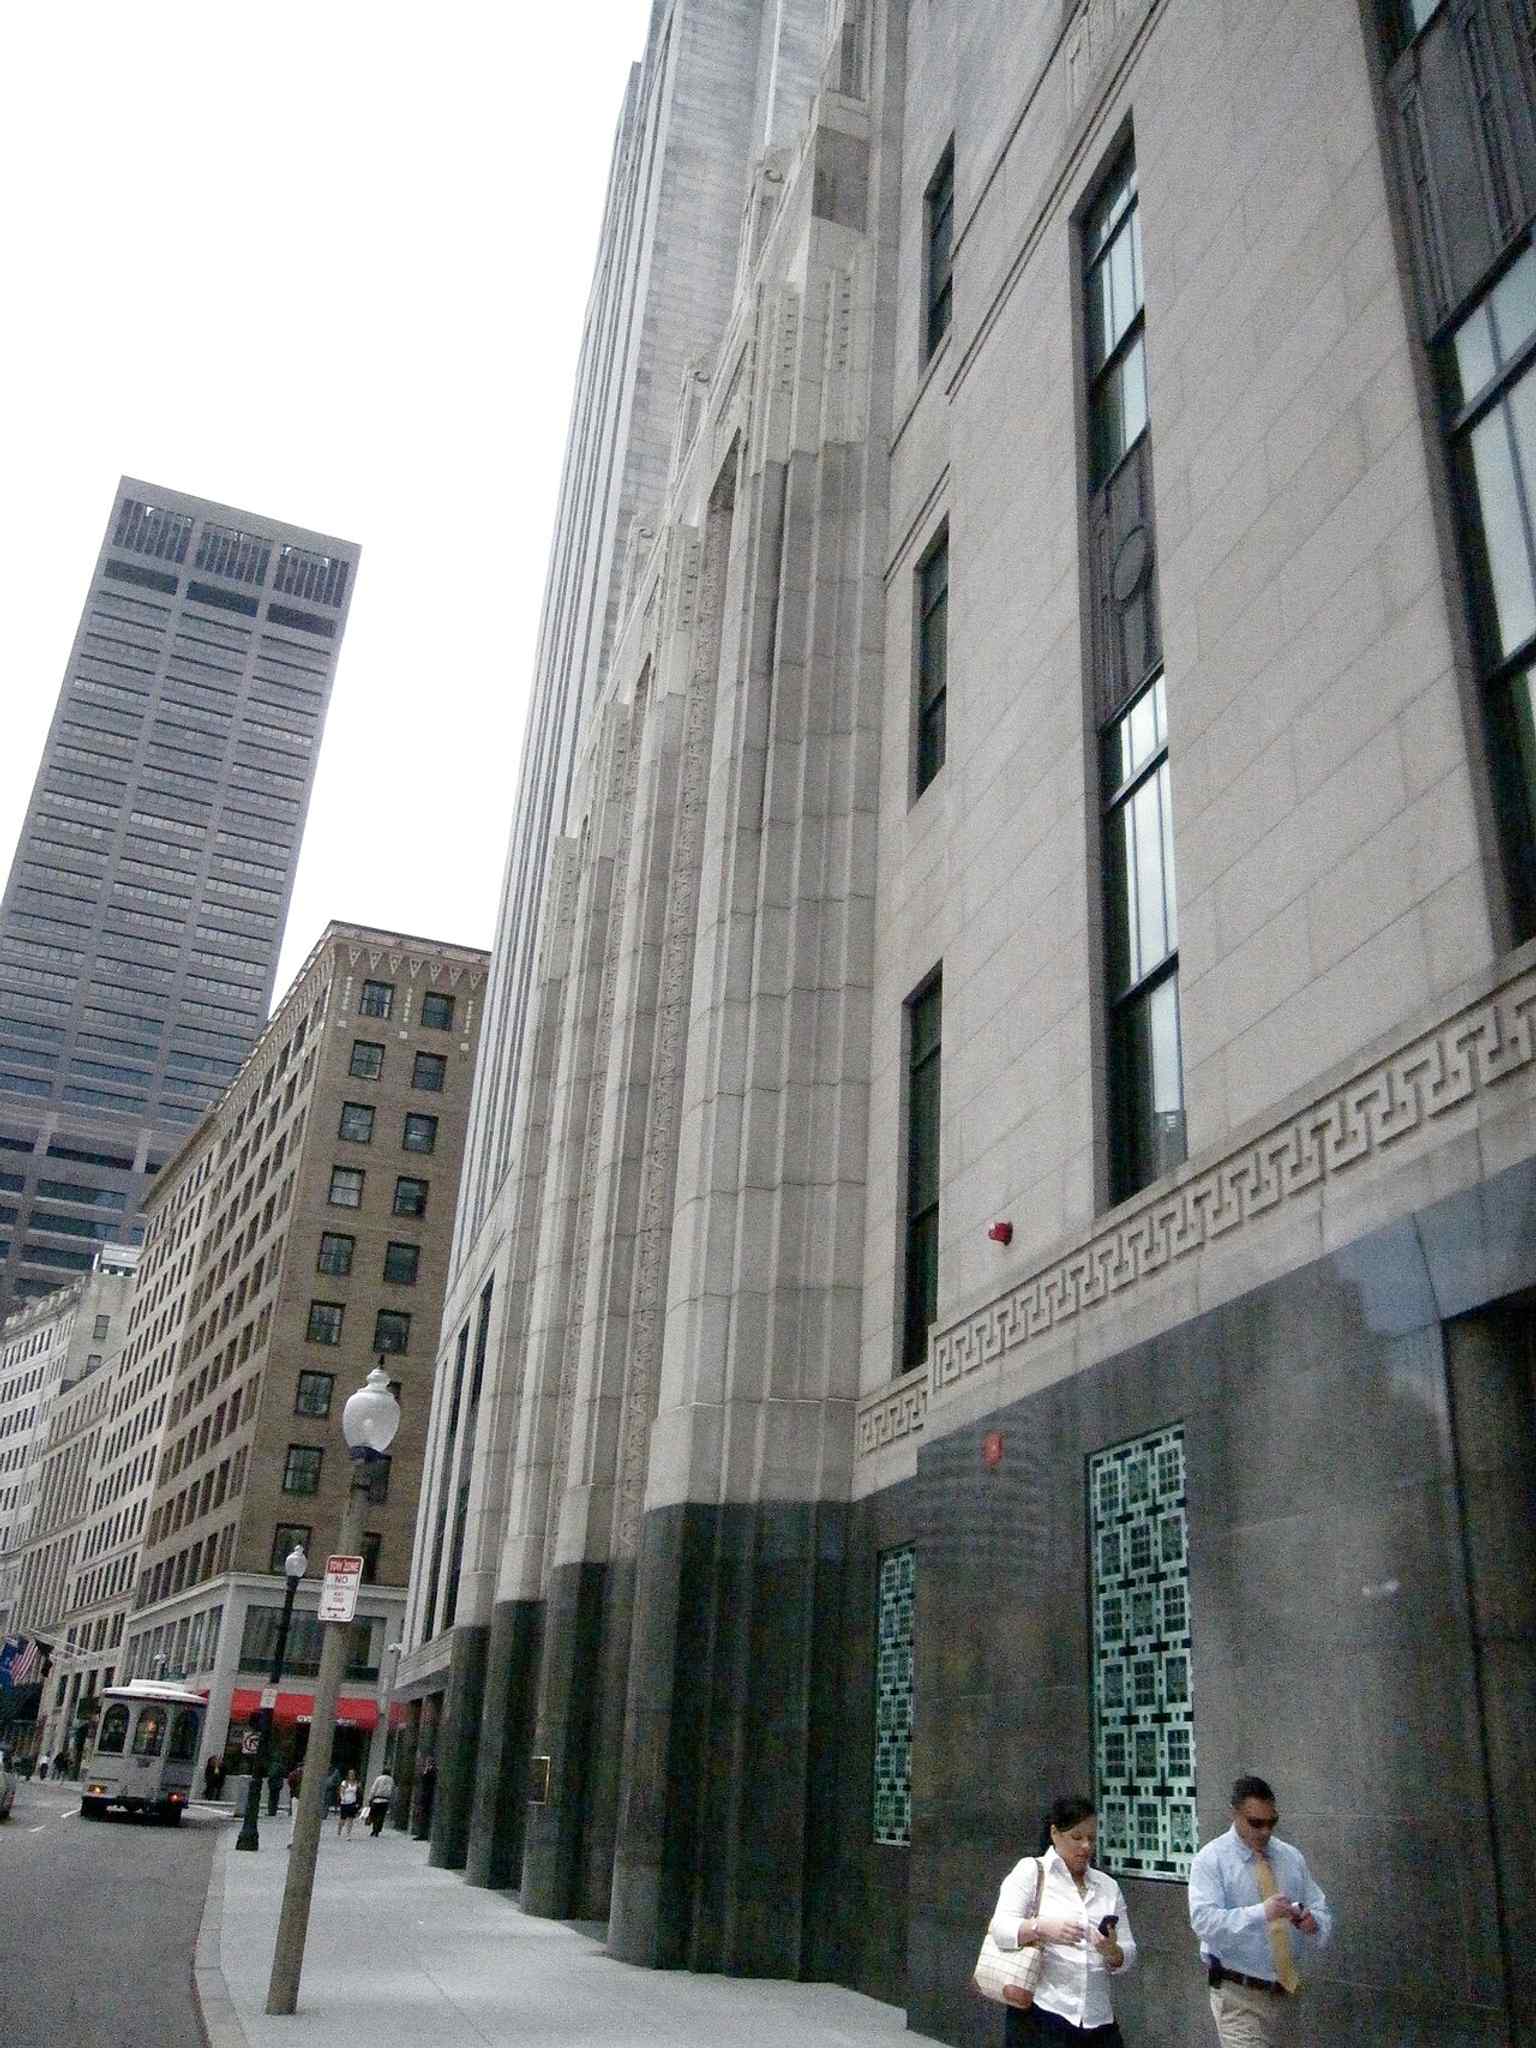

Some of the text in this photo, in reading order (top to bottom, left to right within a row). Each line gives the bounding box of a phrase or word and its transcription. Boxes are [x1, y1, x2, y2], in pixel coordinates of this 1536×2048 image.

[330, 1559, 360, 1573] TOW ZONE
[335, 1575, 349, 1585] NO
